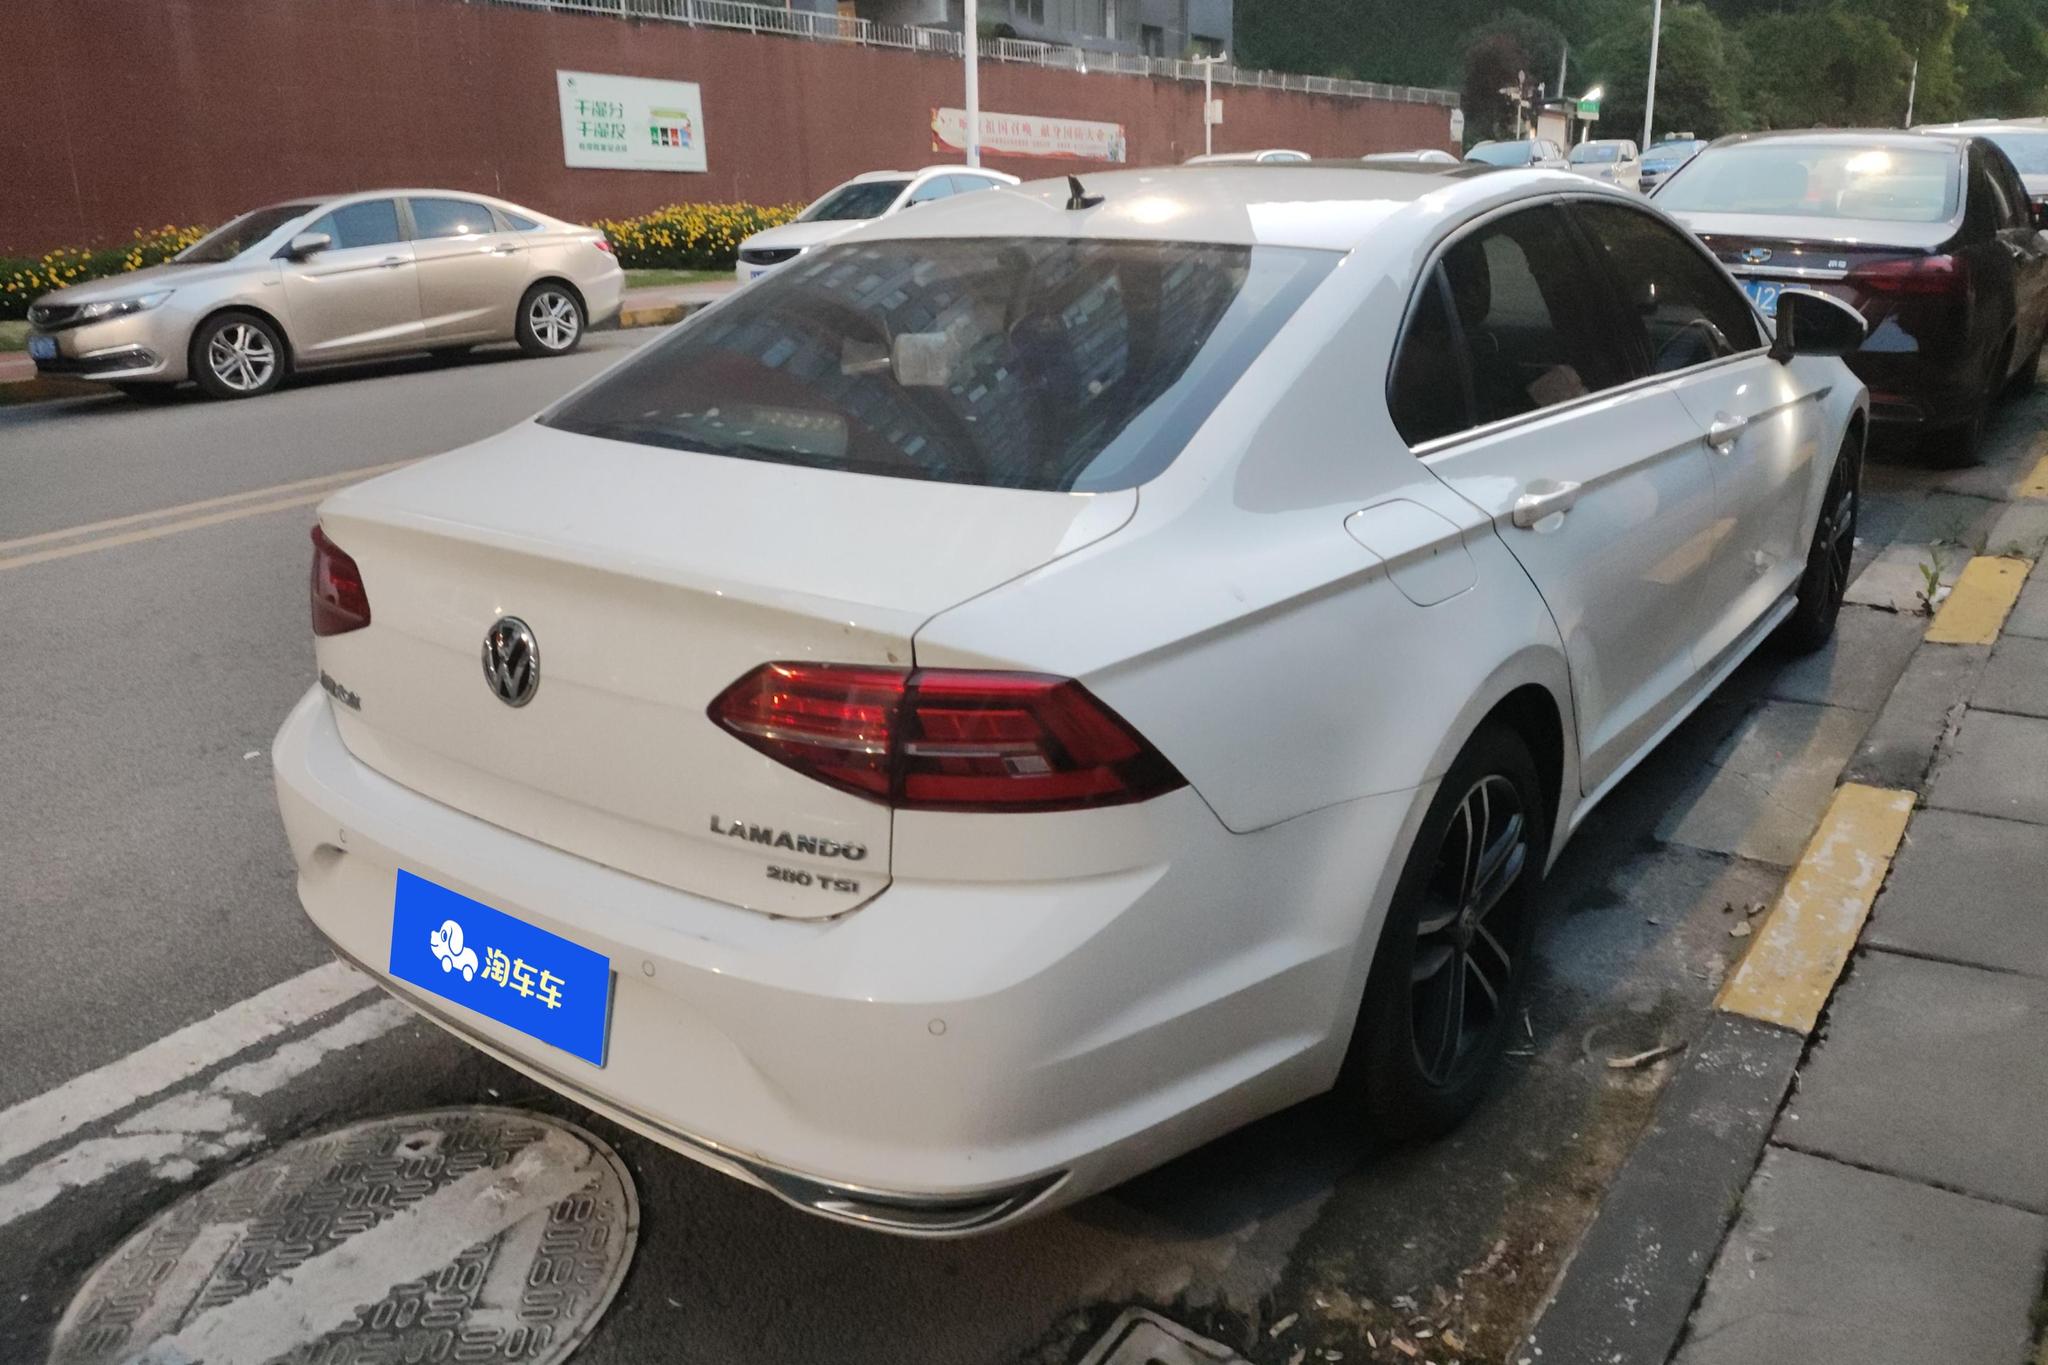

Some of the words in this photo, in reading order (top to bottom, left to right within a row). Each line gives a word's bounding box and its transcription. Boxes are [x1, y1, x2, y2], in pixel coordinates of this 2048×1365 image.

[710, 814, 869, 861] LAMANDO
[766, 865, 813, 887] 280
[817, 874, 861, 894] TSI
